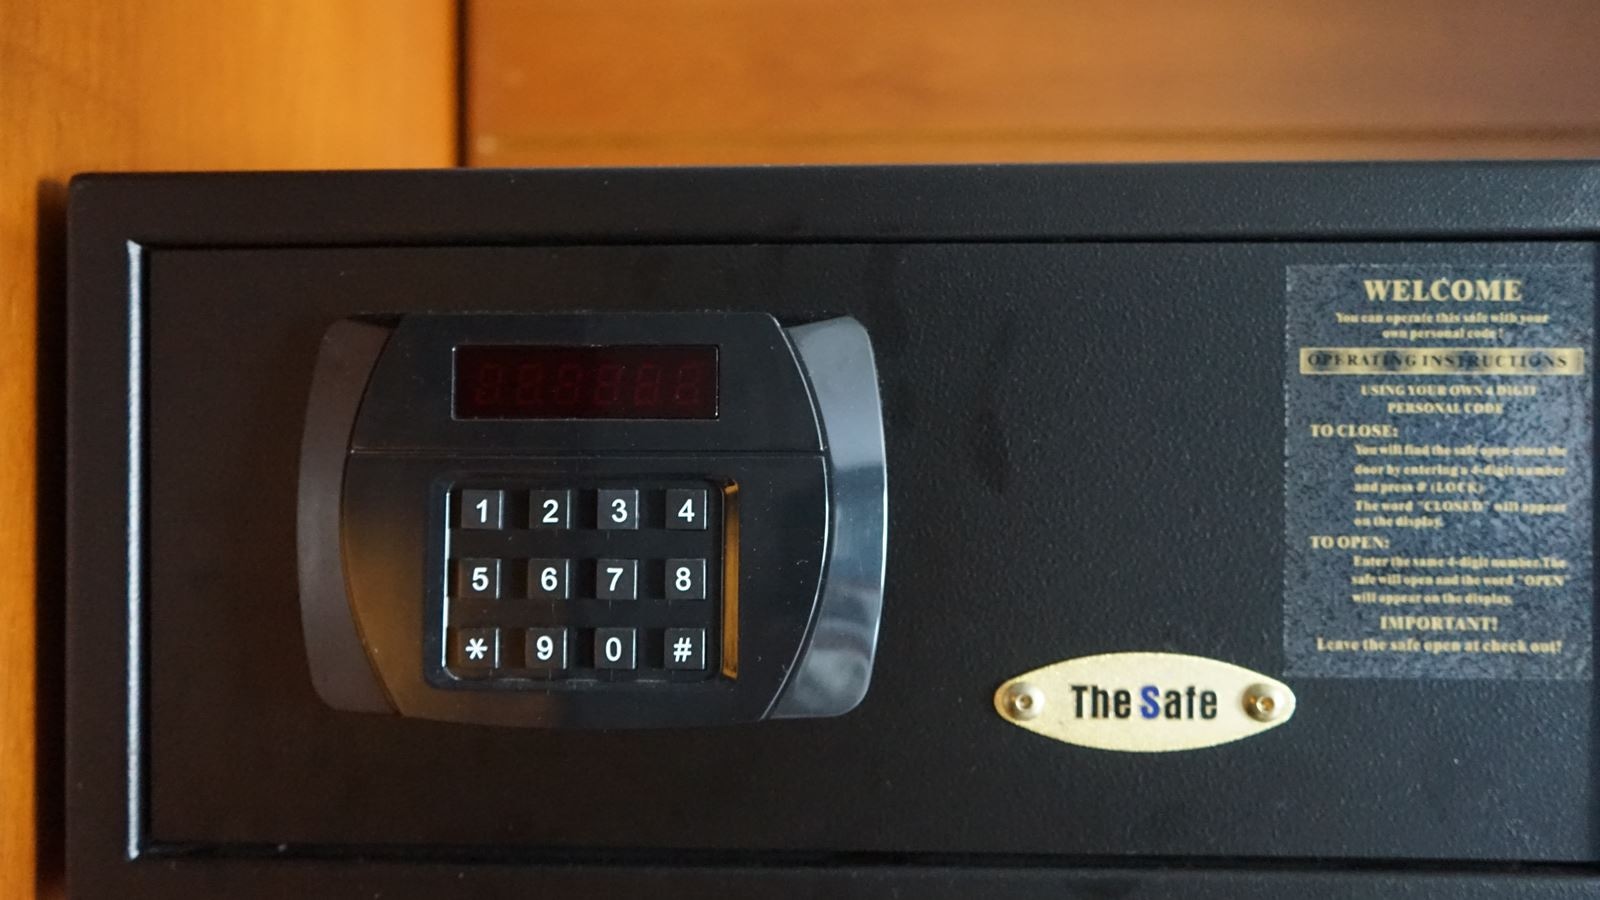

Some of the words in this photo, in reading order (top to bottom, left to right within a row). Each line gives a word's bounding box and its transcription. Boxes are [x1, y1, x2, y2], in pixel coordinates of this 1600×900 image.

[1364, 278, 1522, 302] WELCOME
[1335, 312, 1359, 323] You
[1361, 314, 1383, 323] can
[1385, 313, 1433, 325] operate
[1435, 313, 1460, 323] this
[1462, 313, 1488, 323] safe
[1490, 313, 1518, 323] with
[1520, 314, 1549, 325] your
[1382, 329, 1408, 338] own
[1410, 328, 1465, 341] personal
[1308, 353, 1417, 367] OPERATING
[1422, 354, 1567, 368] INSTRUCTIONS
[1361, 384, 1405, 396] USING
[1407, 384, 1447, 396] YOUR
[1449, 385, 1483, 396] OWN
[1496, 385, 1537, 396] DIGIT
[1387, 402, 1461, 414] PERSONAL
[1463, 402, 1504, 414] CODE
[1310, 424, 1334, 437] TO
[1336, 424, 1399, 437] CLOSE:
[1355, 444, 1378, 456] You
[1379, 444, 1402, 456] will
[1404, 444, 1430, 456] find
[1431, 444, 1452, 456] the
[1453, 445, 1478, 456] safe
[1547, 445, 1568, 456] the
[1354, 464, 1384, 475] door
[1386, 464, 1401, 478] by
[1403, 464, 1459, 477] entering
[1516, 466, 1568, 476] number
[1354, 482, 1378, 493] and
[1380, 483, 1414, 495] press
[476, 498, 488, 523] 1
[542, 498, 559, 523] 2
[611, 498, 628, 523] 3
[677, 498, 696, 523] 4
[1356, 500, 1379, 512] The
[1381, 501, 1414, 512] word
[1493, 500, 1520, 512] will
[1521, 503, 1567, 515] appear
[1354, 517, 1371, 527] on
[1373, 516, 1393, 527] the
[1310, 536, 1334, 549] TO
[1336, 536, 1390, 549] OPEN:
[1353, 555, 1389, 567] Enter
[1391, 556, 1411, 567] the
[1412, 558, 1445, 567] same
[471, 566, 489, 592] 5
[540, 566, 558, 592] 6
[606, 567, 624, 592] 7
[675, 566, 692, 592] 8
[1351, 573, 1377, 585] safe
[1378, 573, 1402, 585] will
[1403, 575, 1434, 587] open
[1435, 575, 1460, 586] and
[1461, 575, 1480, 586] the
[1482, 575, 1514, 586] word
[1352, 592, 1377, 603] will
[1378, 594, 1422, 605] appear
[1423, 594, 1441, 604] on
[1442, 593, 1463, 604] the
[1380, 616, 1499, 631] IMPORTANT!
[536, 635, 554, 661] 9
[605, 636, 622, 662] 0
[673, 636, 693, 663] #
[1316, 637, 1361, 651] Leave
[1362, 639, 1387, 651] the
[1390, 639, 1421, 651] safe
[1423, 641, 1461, 655] open
[1463, 641, 1480, 652] at
[1482, 640, 1527, 653] check
[1529, 640, 1563, 653] out!
[1071, 685, 1131, 719] The
[1141, 685, 1217, 719] Safe
